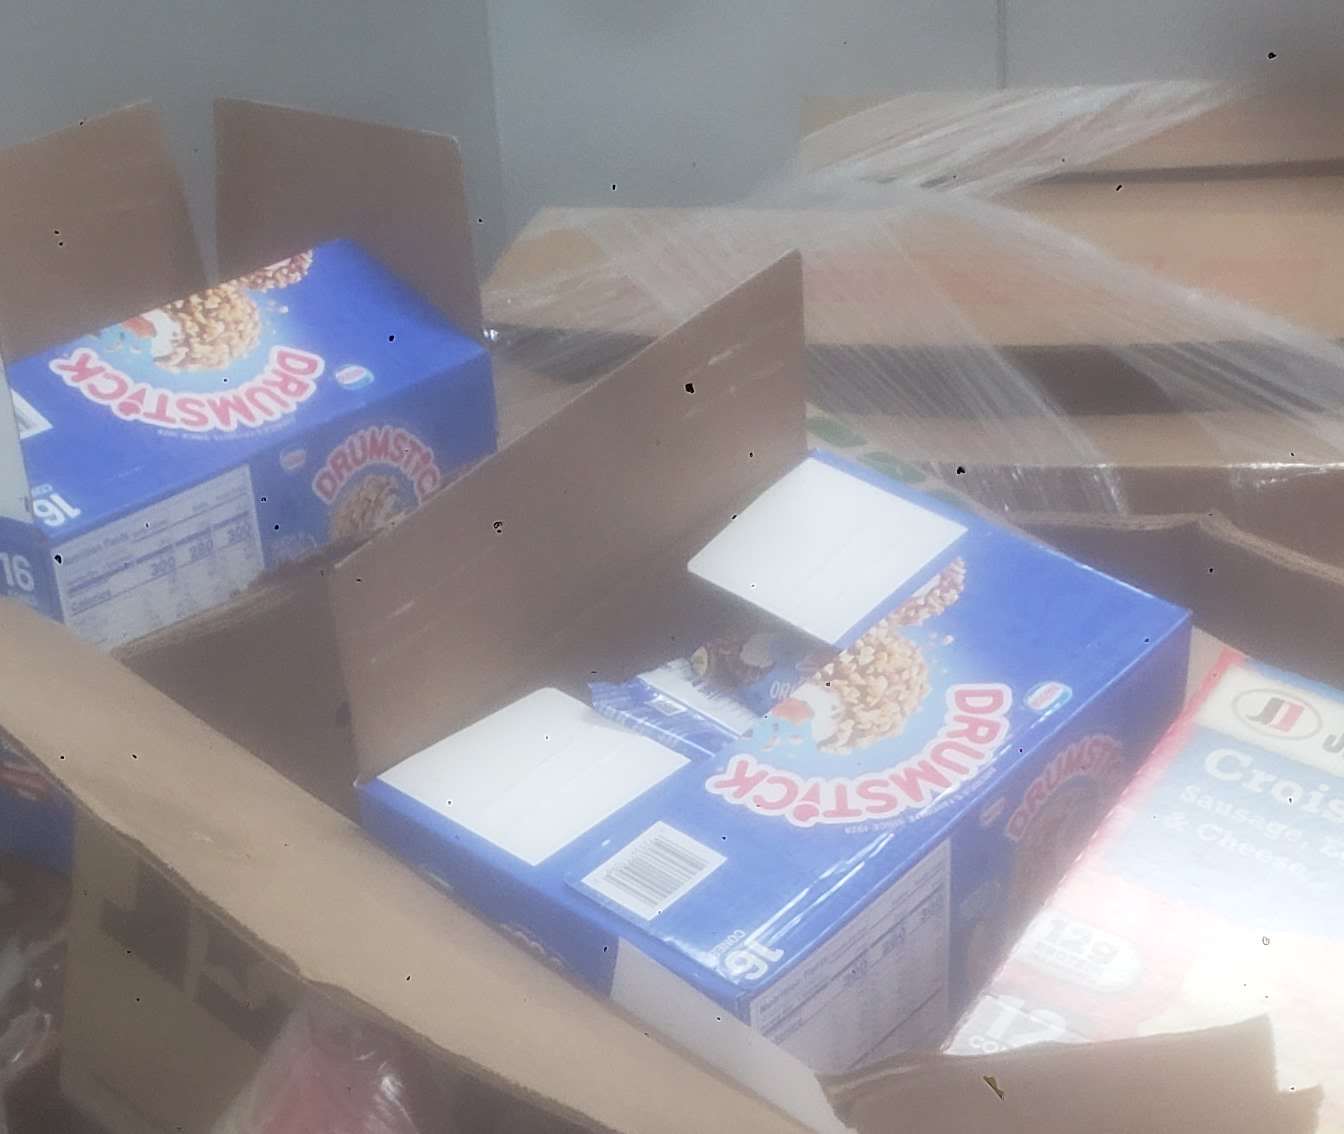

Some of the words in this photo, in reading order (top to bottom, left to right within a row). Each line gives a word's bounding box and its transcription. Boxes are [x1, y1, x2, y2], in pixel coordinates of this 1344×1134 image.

[52, 347, 325, 431] DRUMSTICK
[0, 551, 34, 592] 16
[706, 683, 1013, 825] DRUMSTICK
[1196, 816, 1310, 880] Cheese
[722, 939, 785, 981] 16
[1044, 917, 1121, 967] 12g
